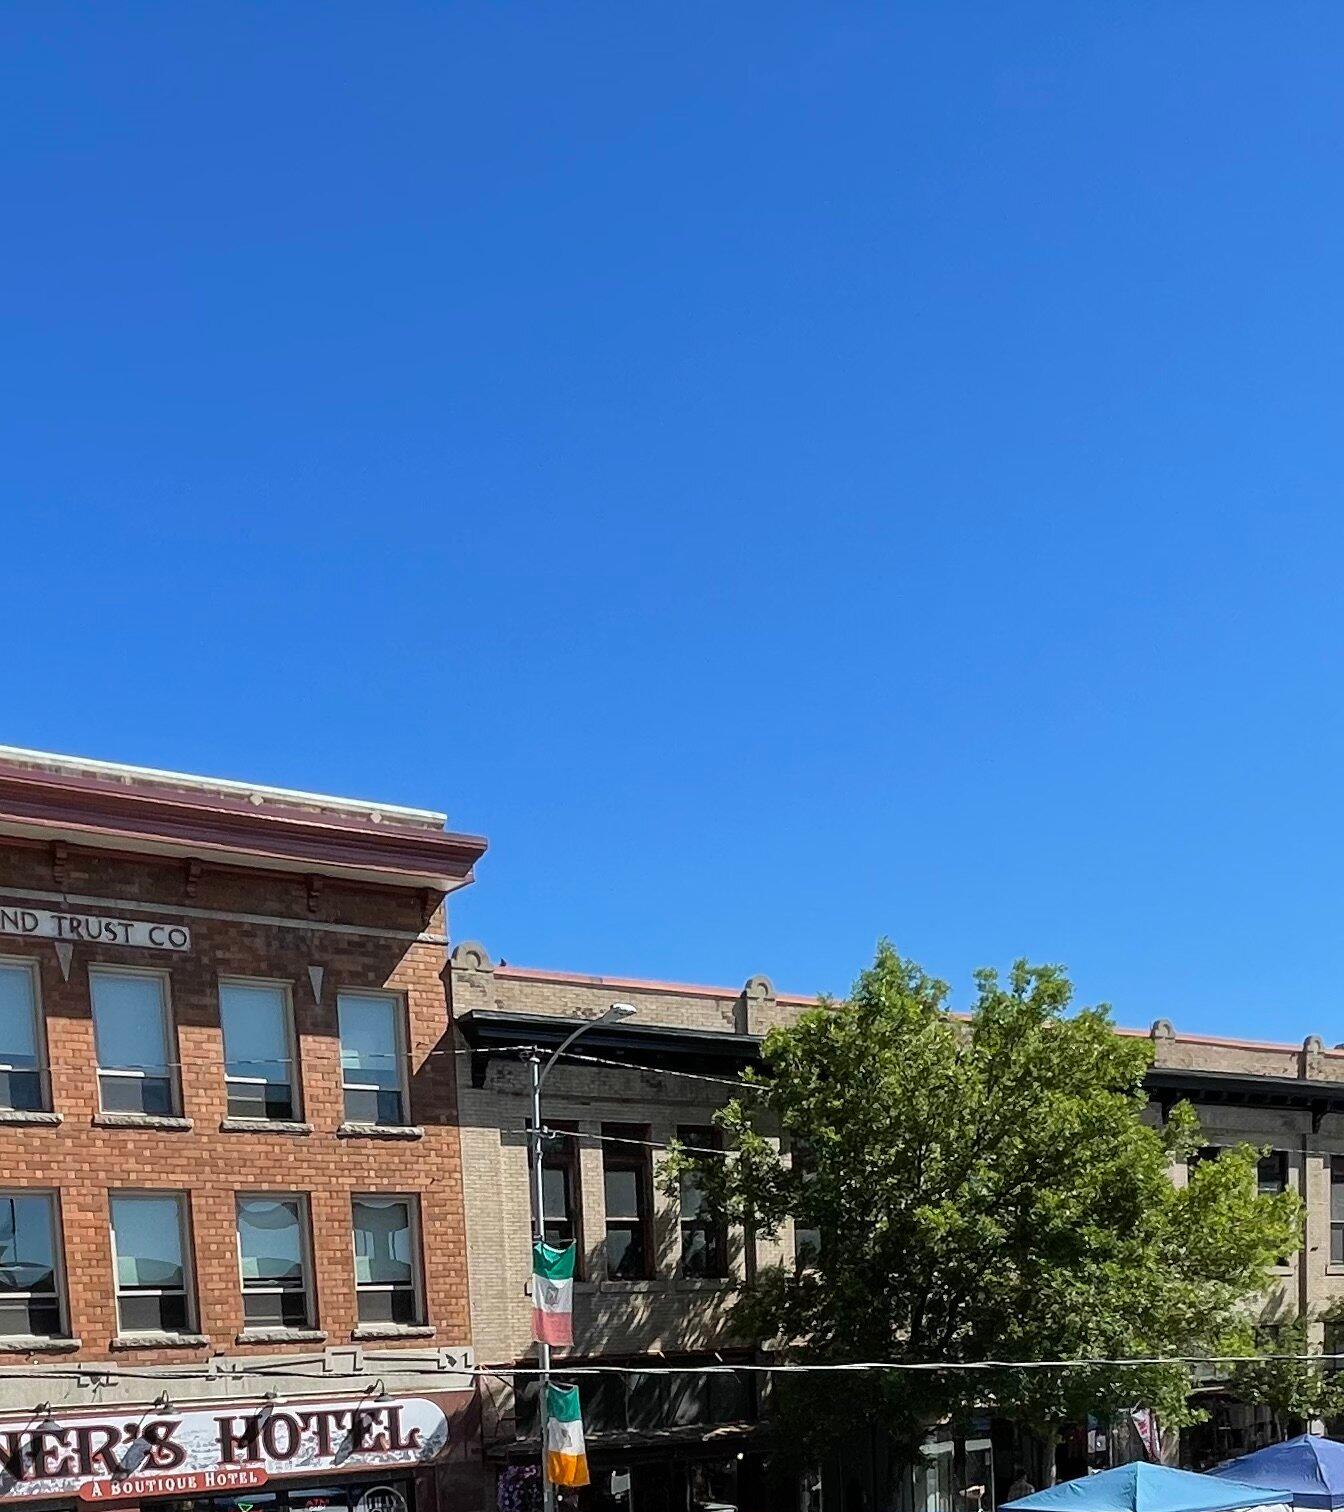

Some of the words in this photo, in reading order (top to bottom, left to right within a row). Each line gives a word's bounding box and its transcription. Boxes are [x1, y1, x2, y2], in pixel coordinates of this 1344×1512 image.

[50, 914, 134, 944] TRUST
[148, 926, 188, 948] CO
[213, 1405, 422, 1464] HOTEL
[91, 1480, 103, 1497] A
[111, 1476, 198, 1496] BOUTIQUE
[204, 1470, 258, 1487] HOTEL
